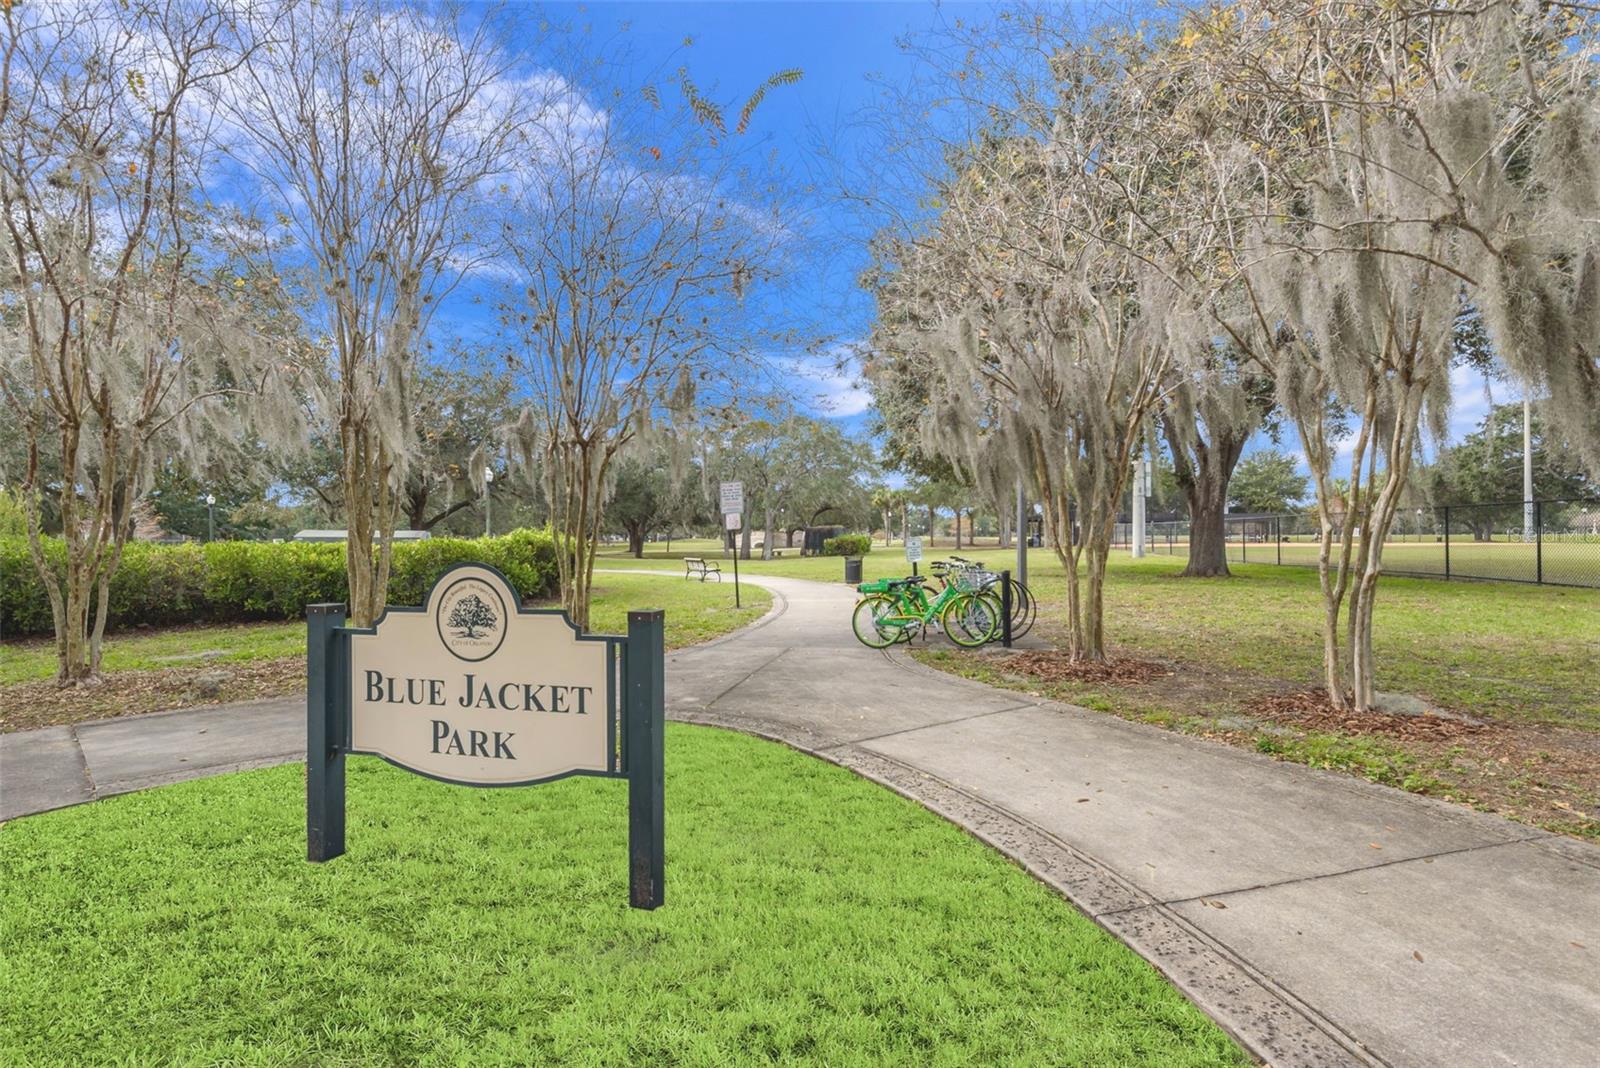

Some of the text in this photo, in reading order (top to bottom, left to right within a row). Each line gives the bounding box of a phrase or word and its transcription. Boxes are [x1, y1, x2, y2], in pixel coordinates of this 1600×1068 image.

[364, 669, 593, 714] BLUE JACKET
[431, 720, 516, 760] PARK
